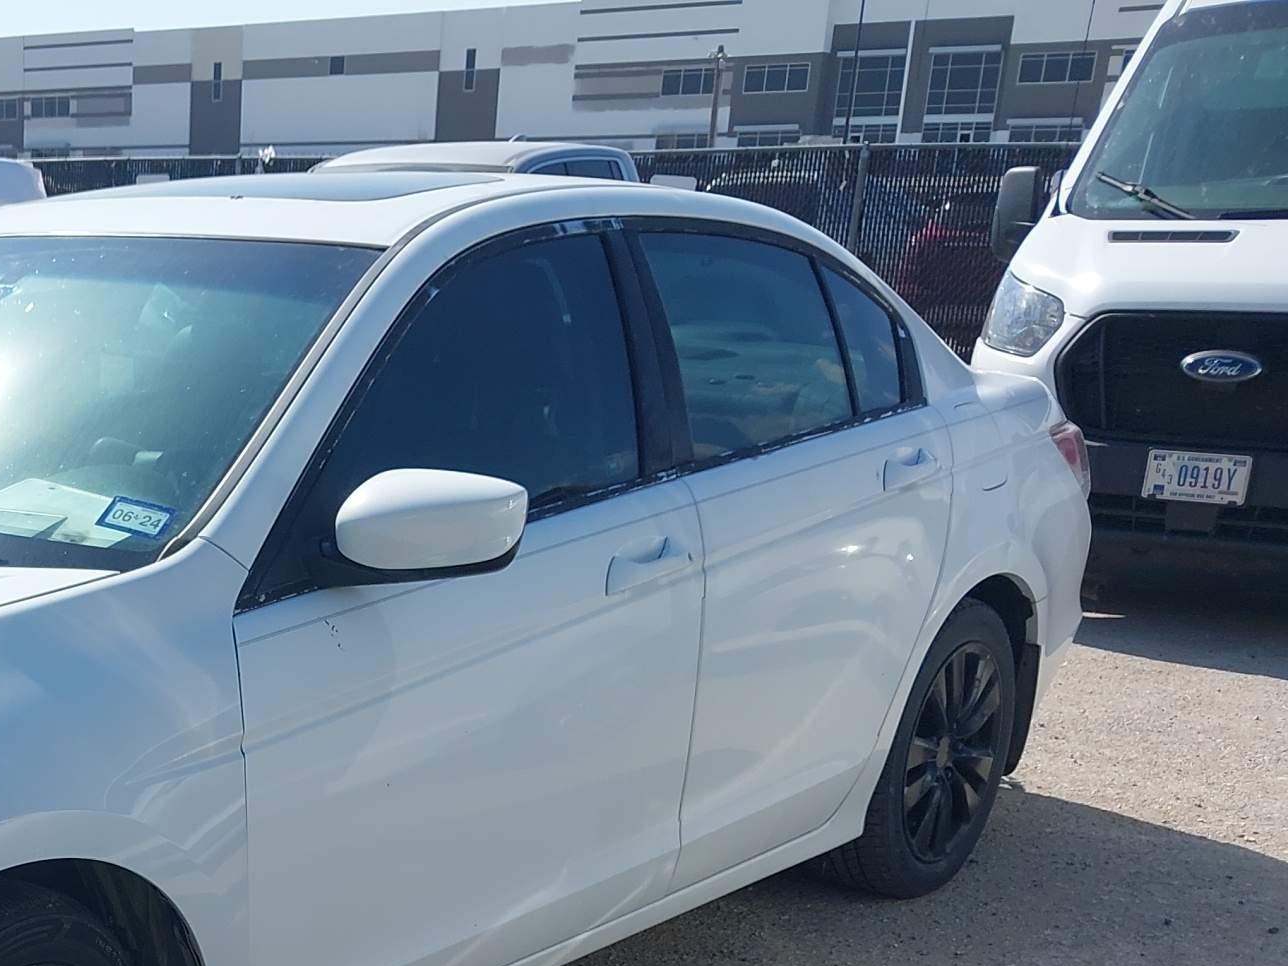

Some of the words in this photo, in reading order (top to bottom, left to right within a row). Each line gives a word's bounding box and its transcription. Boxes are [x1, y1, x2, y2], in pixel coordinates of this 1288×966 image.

[1198, 358, 1242, 376] Ford
[1176, 464, 1238, 491] 0919Y
[112, 508, 135, 522] 06
[139, 515, 162, 530] 24
